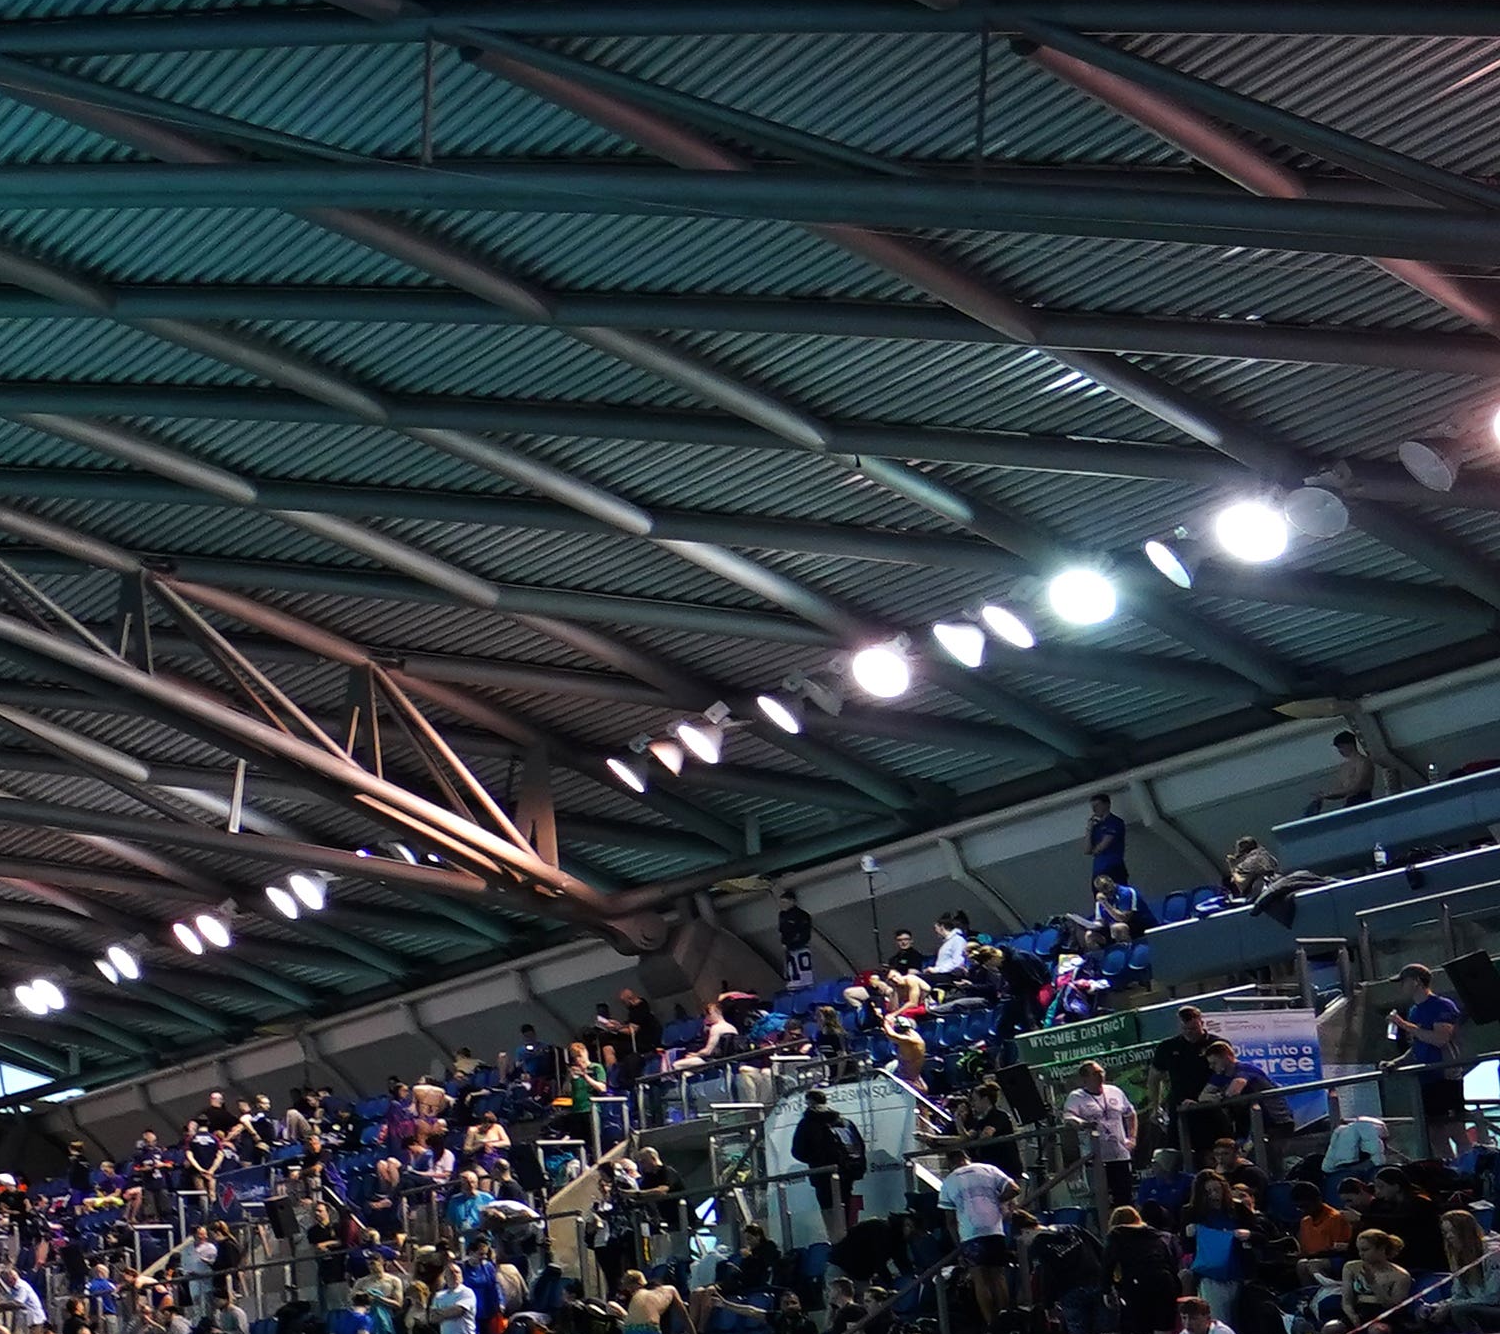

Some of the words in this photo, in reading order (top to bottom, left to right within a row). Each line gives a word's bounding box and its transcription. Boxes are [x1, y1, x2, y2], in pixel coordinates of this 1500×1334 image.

[1030, 1030, 1077, 1049] WYCOMBE
[1081, 1017, 1126, 1040] DISTRICT
[1268, 1044, 1299, 1056] into
[1301, 1045, 1313, 1055] a
